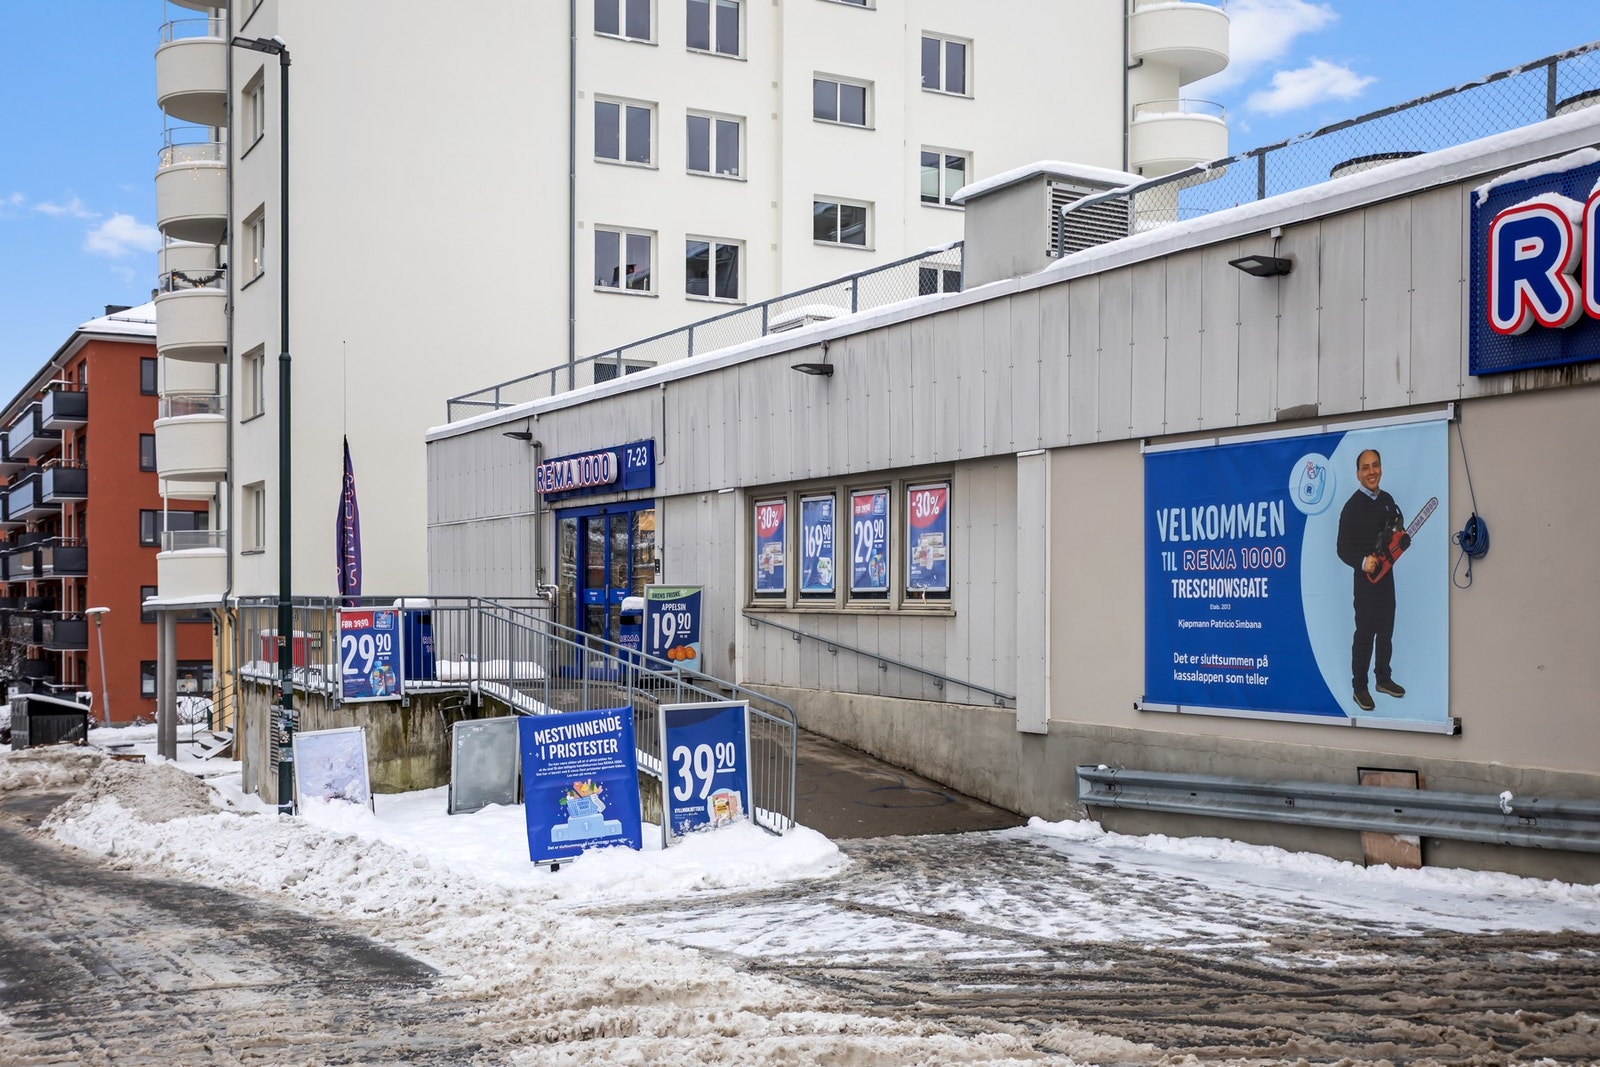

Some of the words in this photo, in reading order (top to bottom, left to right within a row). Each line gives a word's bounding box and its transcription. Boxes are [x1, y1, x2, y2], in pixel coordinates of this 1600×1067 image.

[627, 446, 647, 468] 7-23
[536, 460, 574, 493] REMA
[577, 452, 612, 486] 1000
[1306, 484, 1314, 494] R
[912, 491, 940, 518] -30%
[758, 506, 779, 530] -30%
[1156, 500, 1286, 542] VELKOMMEN
[1162, 551, 1178, 572] TIL
[1183, 548, 1237, 571] REMA
[1241, 546, 1286, 569] 1000
[1172, 578, 1268, 598] TRESCHOWSGATE
[662, 603, 686, 611] APPELSIN
[1178, 619, 1209, 629] Kjøpmann
[1210, 620, 1234, 628] Patricio
[1174, 652, 1188, 664] Det
[1200, 654, 1254, 666] sluttsummen
[1256, 654, 1268, 669] på
[1174, 669, 1223, 684] kassalappen
[1226, 674, 1244, 683] som
[1246, 673, 1269, 685] teller
[534, 716, 622, 746] MESTVINNENDE
[541, 746, 545, 760] I
[549, 739, 618, 759] PRISTESTER
